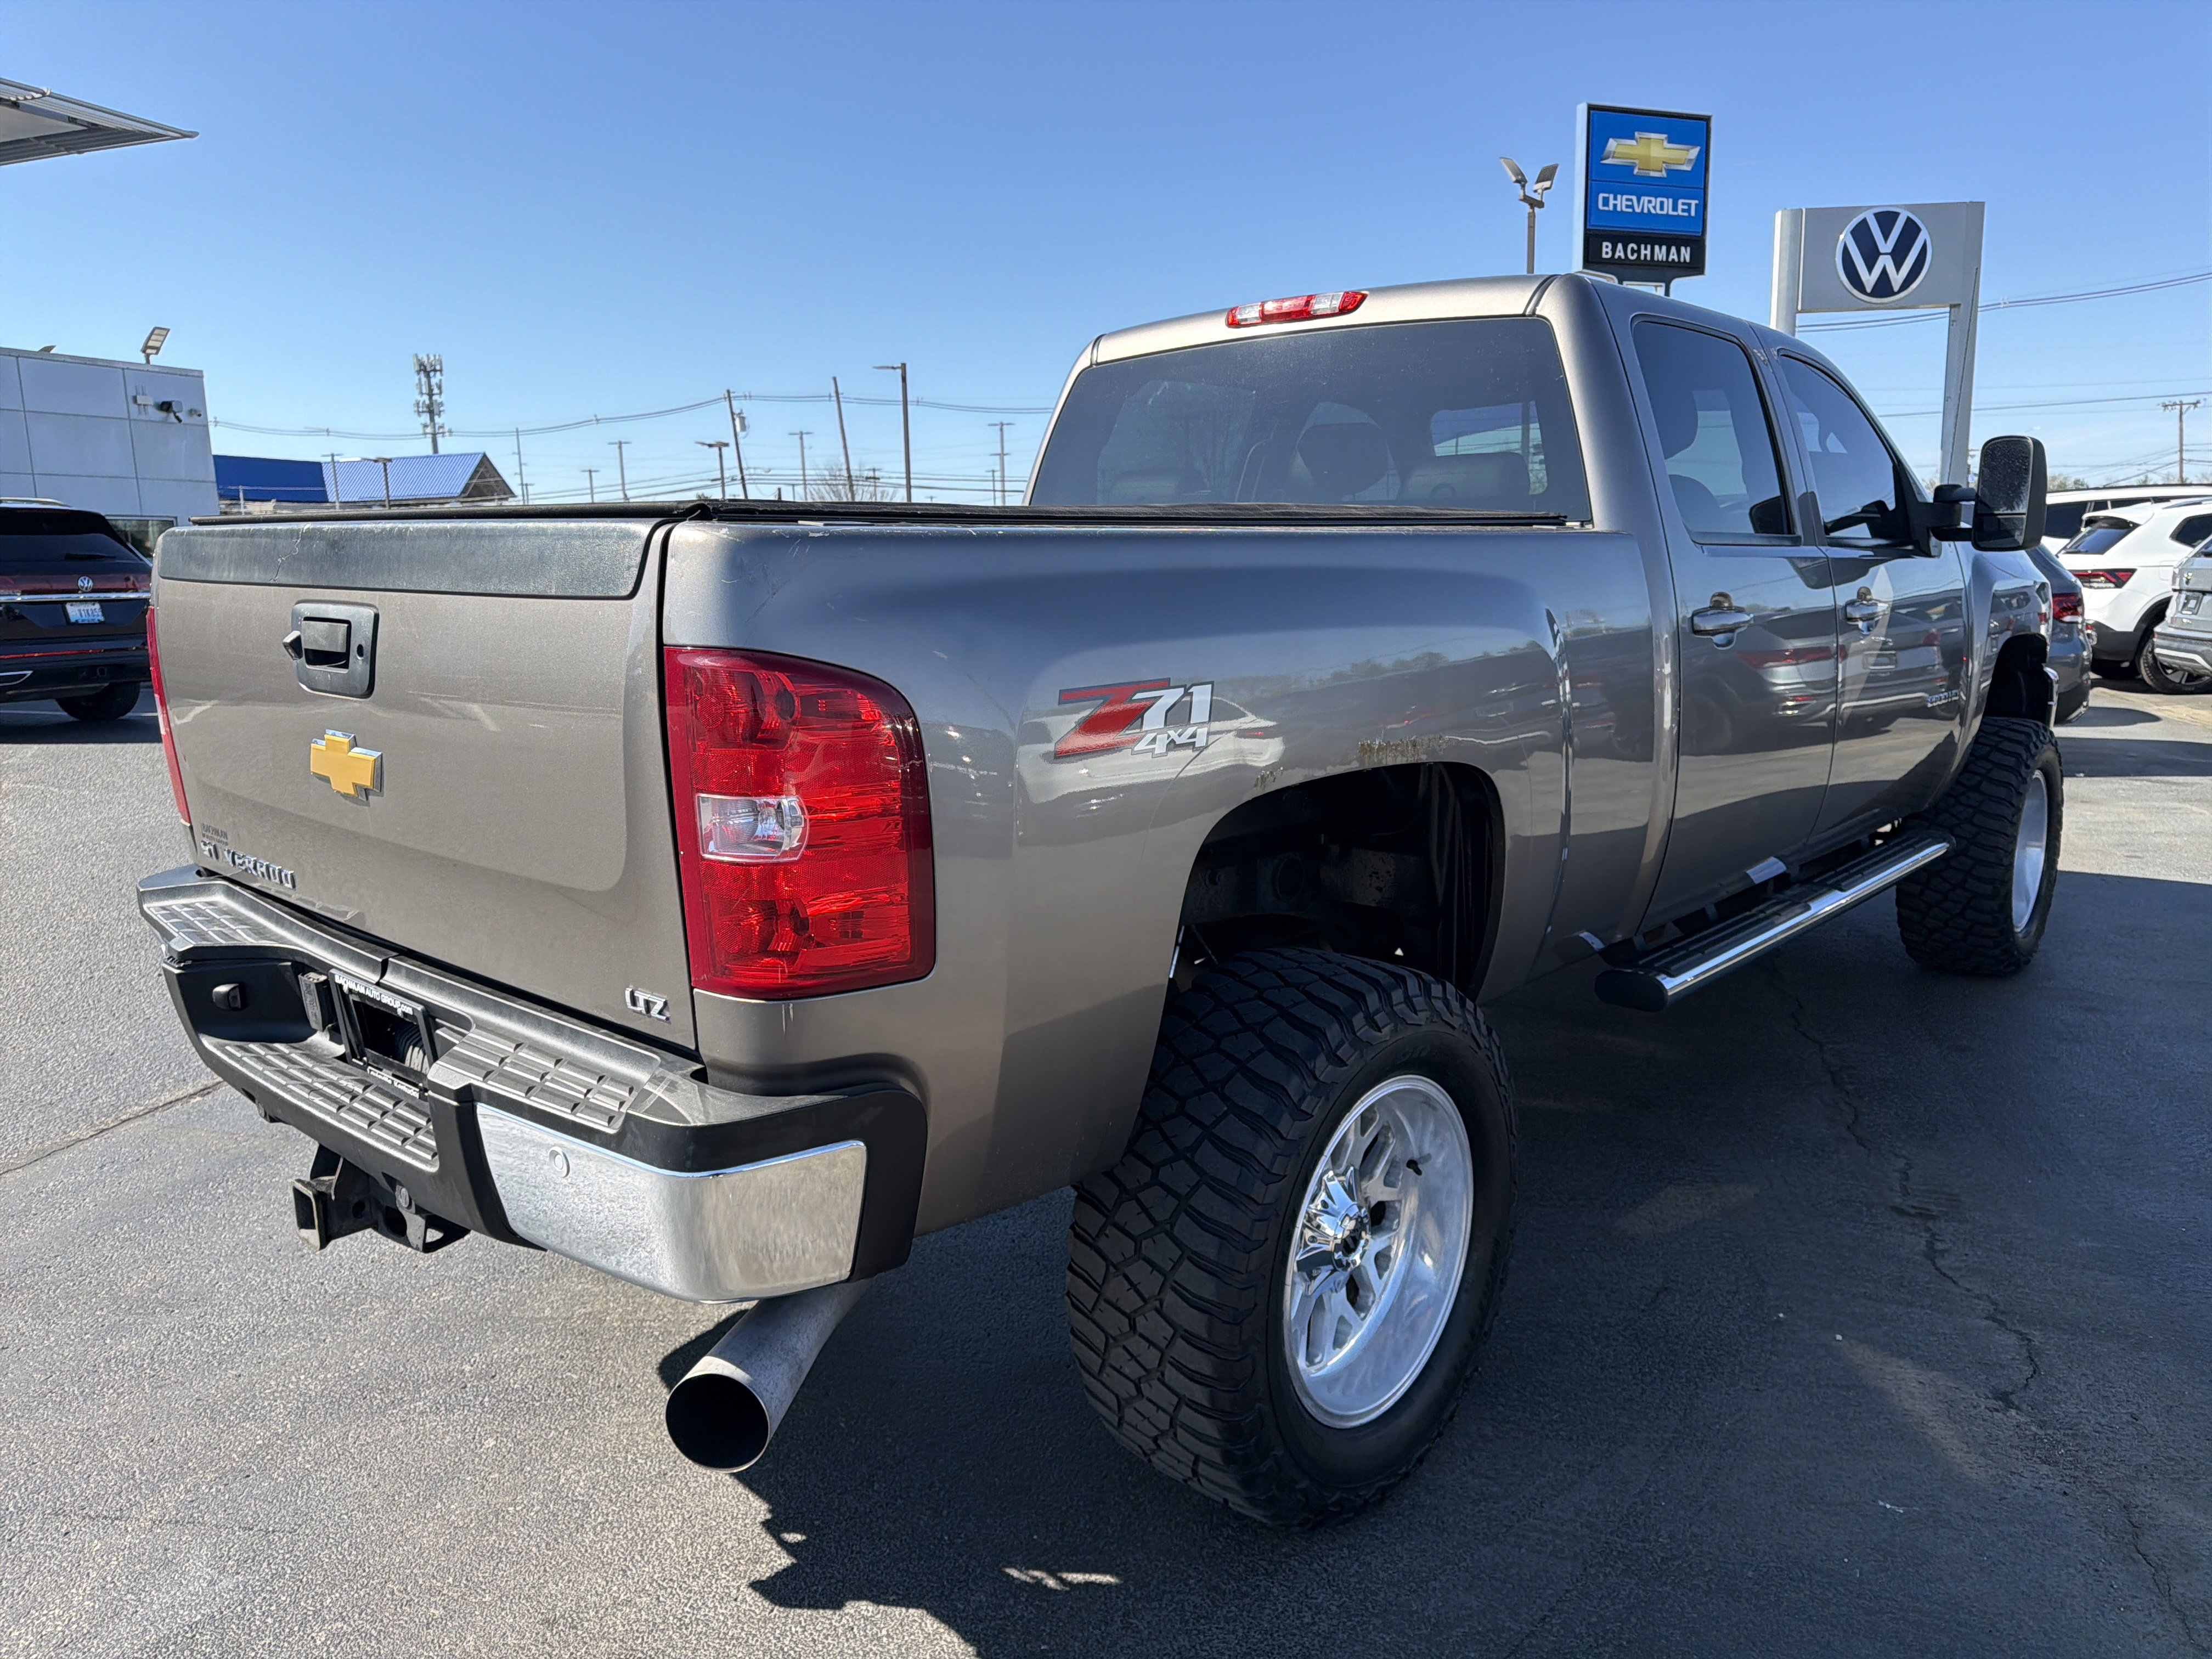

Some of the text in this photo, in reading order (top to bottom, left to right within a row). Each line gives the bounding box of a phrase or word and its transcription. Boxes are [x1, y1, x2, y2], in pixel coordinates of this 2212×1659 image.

[1598, 193, 1699, 217] CHEVROLET
[1601, 241, 1691, 263] BACHMAN
[1837, 207, 1931, 301] VW
[1054, 677, 1215, 759] Z71
[201, 840, 297, 890] SIVERADO
[335, 974, 365, 995] BACHMAN
[365, 987, 381, 1001] AUTO
[624, 987, 670, 1023] LTZ
